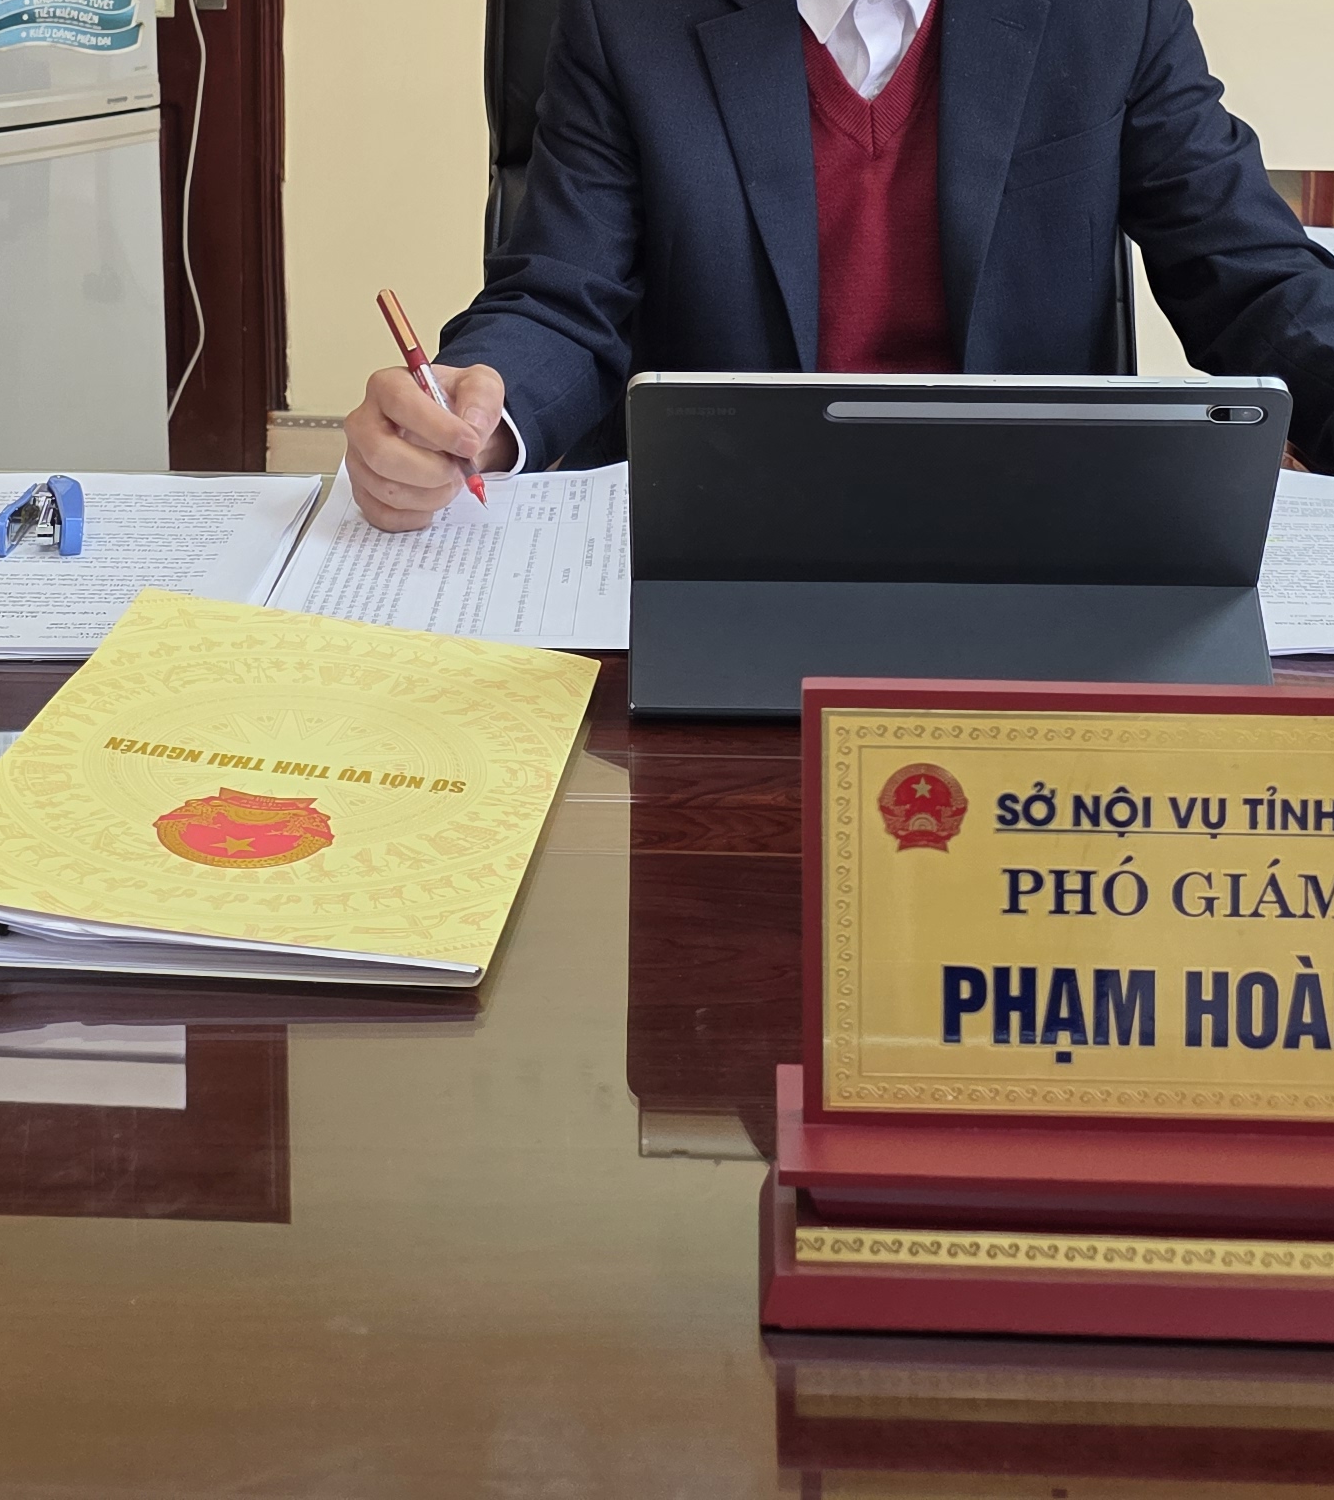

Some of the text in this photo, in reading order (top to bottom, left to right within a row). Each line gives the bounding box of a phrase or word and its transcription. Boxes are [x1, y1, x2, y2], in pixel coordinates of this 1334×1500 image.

[104, 736, 467, 795] SỞ NỘI VỤ TỈNH THÁI NGUYÊN
[996, 780, 1057, 828] SỞ
[1072, 786, 1152, 838] NỘI
[1168, 796, 1228, 839] VỤ
[1001, 855, 1149, 917] PHÓ
[940, 964, 1158, 1064] PHẠM
